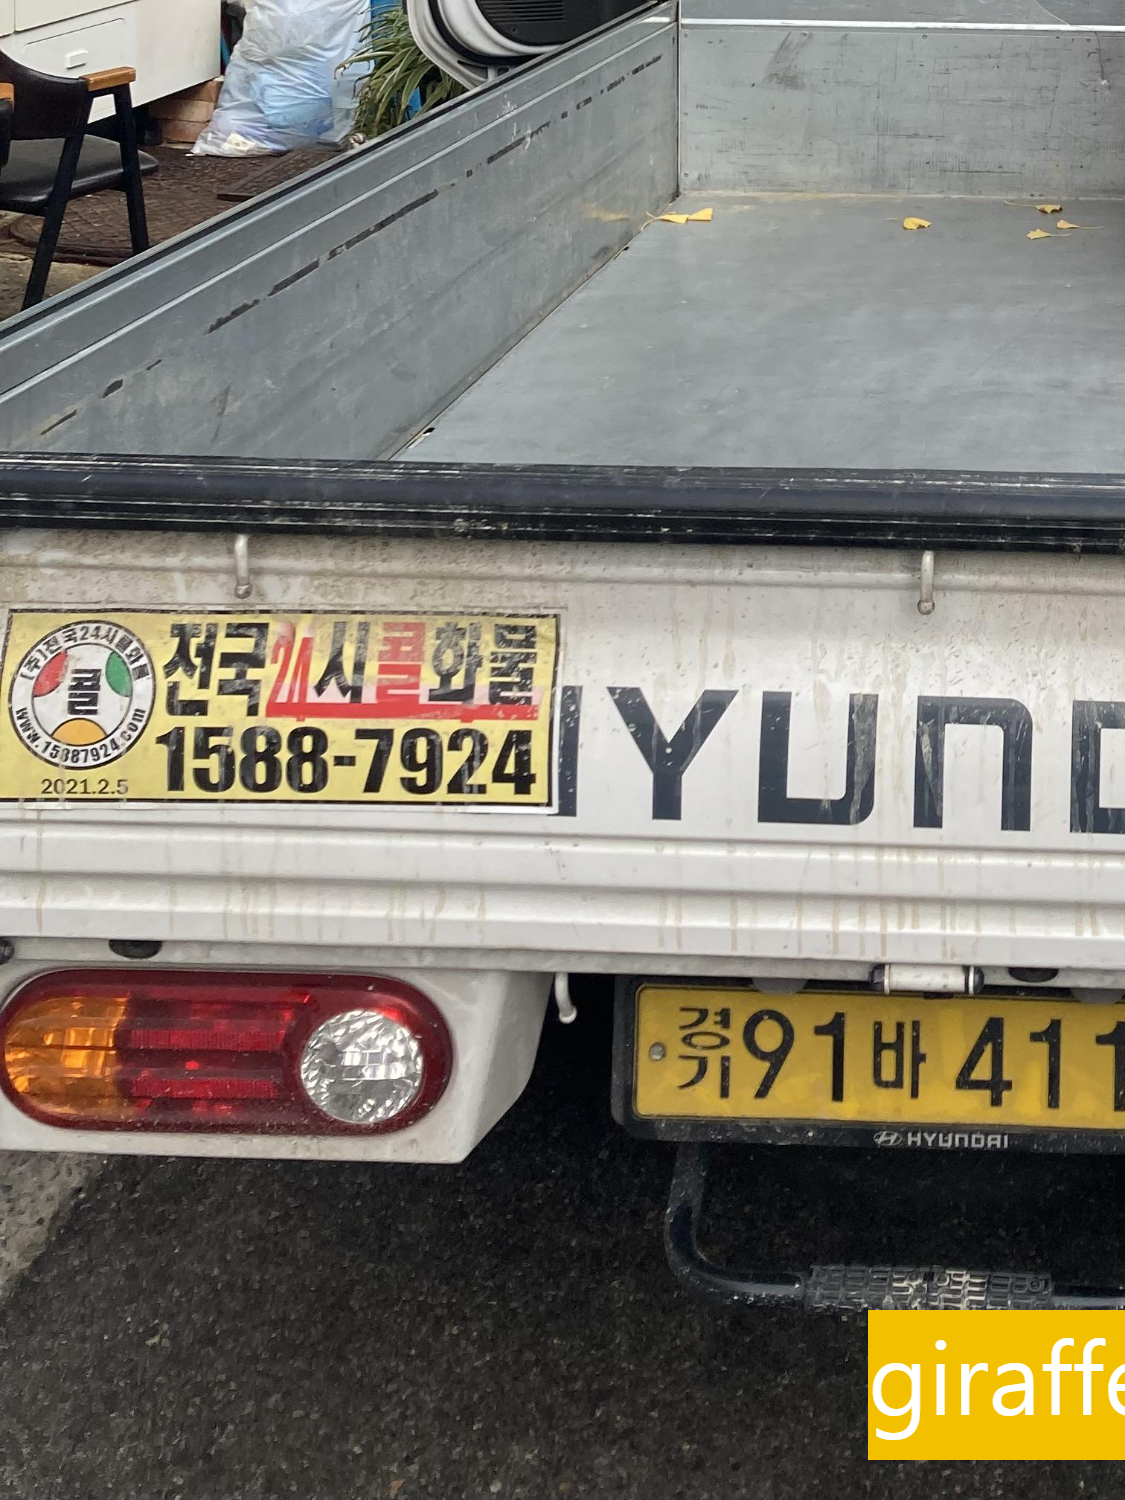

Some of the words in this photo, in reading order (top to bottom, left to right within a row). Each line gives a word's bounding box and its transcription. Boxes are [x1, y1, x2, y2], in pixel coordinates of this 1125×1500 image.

[155, 723, 537, 796] 1588-7924
[41, 777, 129, 796] 2021.2.5
[907, 1131, 1010, 1150] HYUNDAI
